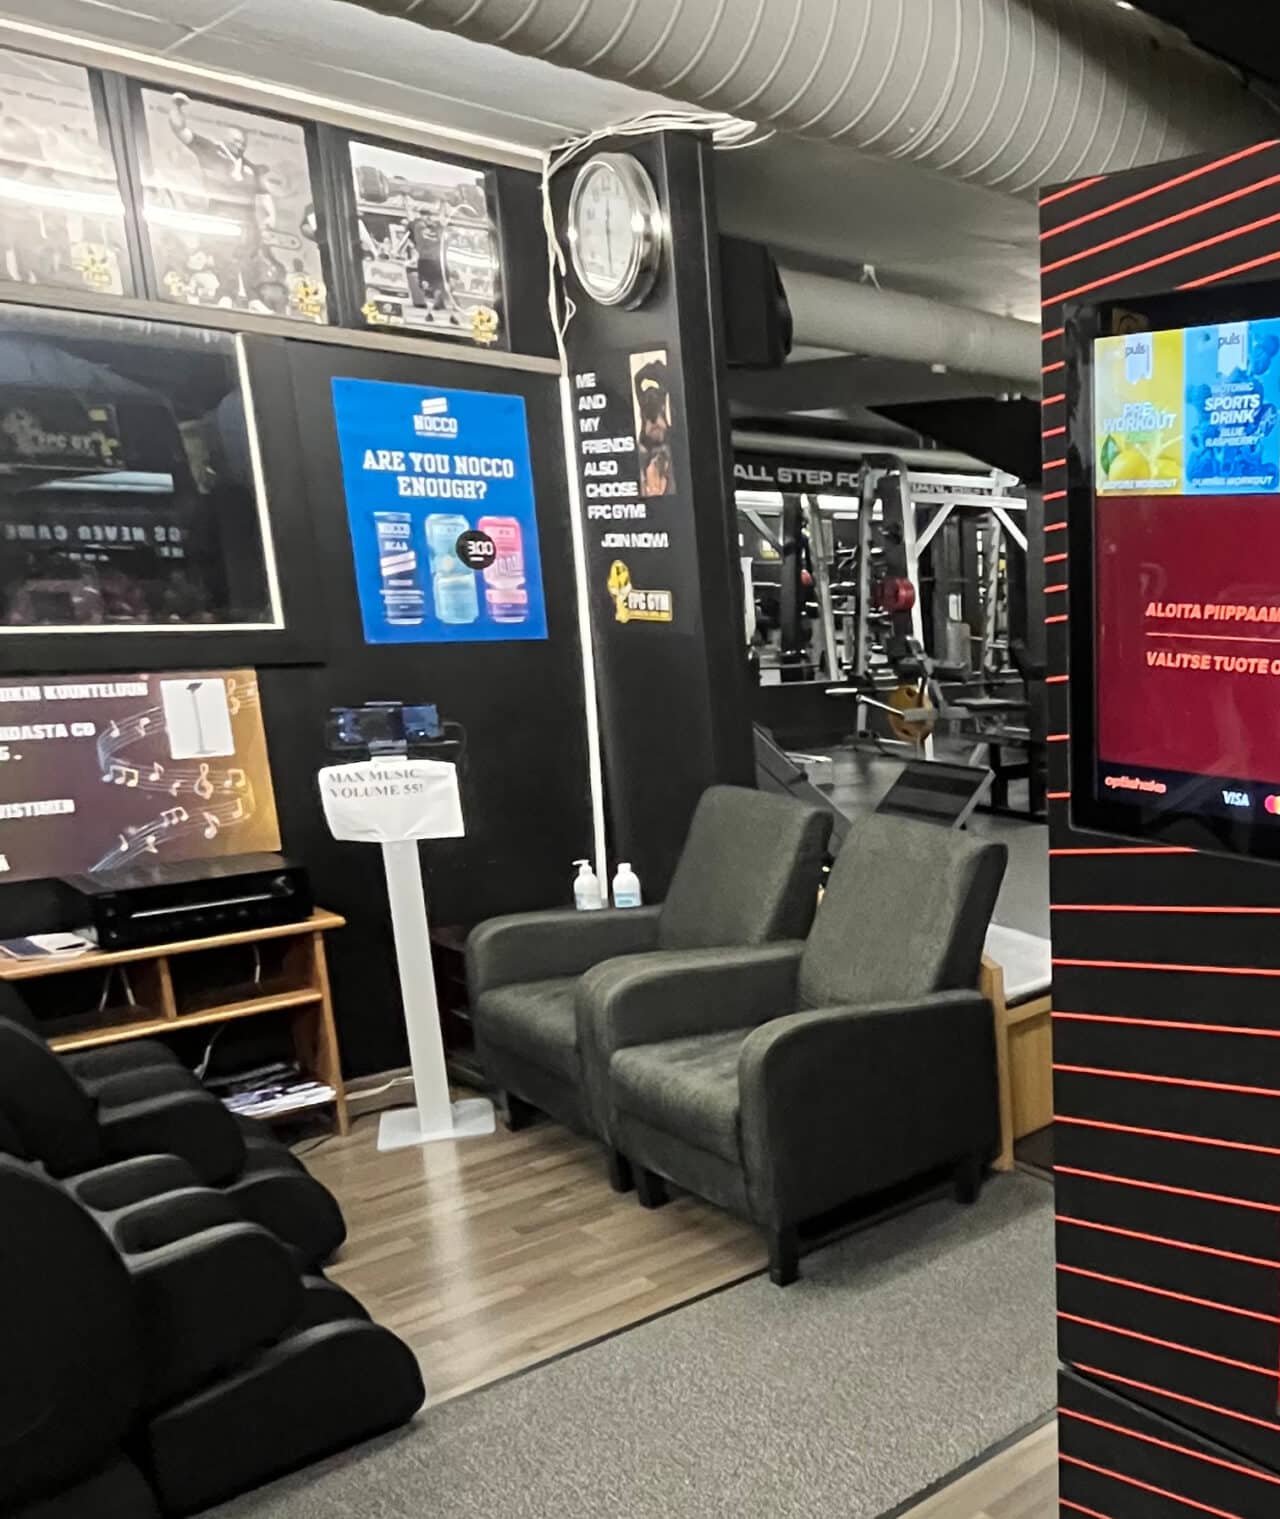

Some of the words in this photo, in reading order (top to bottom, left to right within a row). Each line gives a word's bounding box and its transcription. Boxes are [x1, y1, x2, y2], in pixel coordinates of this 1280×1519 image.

[1218, 333, 1240, 349] puls
[576, 372, 596, 389] ME
[578, 394, 607, 411] AND
[1205, 394, 1260, 411] SPORTS
[413, 415, 458, 434] NOCCO
[580, 416, 600, 432] MY
[1103, 413, 1176, 431] WORKOUT
[1210, 410, 1255, 425] DRINK
[582, 436, 635, 454] FRIENDS
[363, 450, 406, 472] ARE
[409, 452, 450, 474] YOU
[453, 455, 515, 479] NOCCO
[584, 460, 618, 477] ALSO
[777, 467, 834, 484] STEP
[397, 476, 487, 500] ENOUGH?
[585, 482, 639, 498] CHOOSE
[587, 505, 612, 520] FPC
[601, 533, 631, 548] JOIN
[1146, 602, 1201, 619] ALOITA
[1146, 651, 1212, 671] VALITSE
[1213, 655, 1267, 675] TUOTE
[328, 772, 365, 784] MAX
[368, 769, 420, 782] MUSIC
[330, 785, 400, 798] VOLUME
[404, 783, 424, 794] 55!
[1222, 790, 1249, 806] VISA
